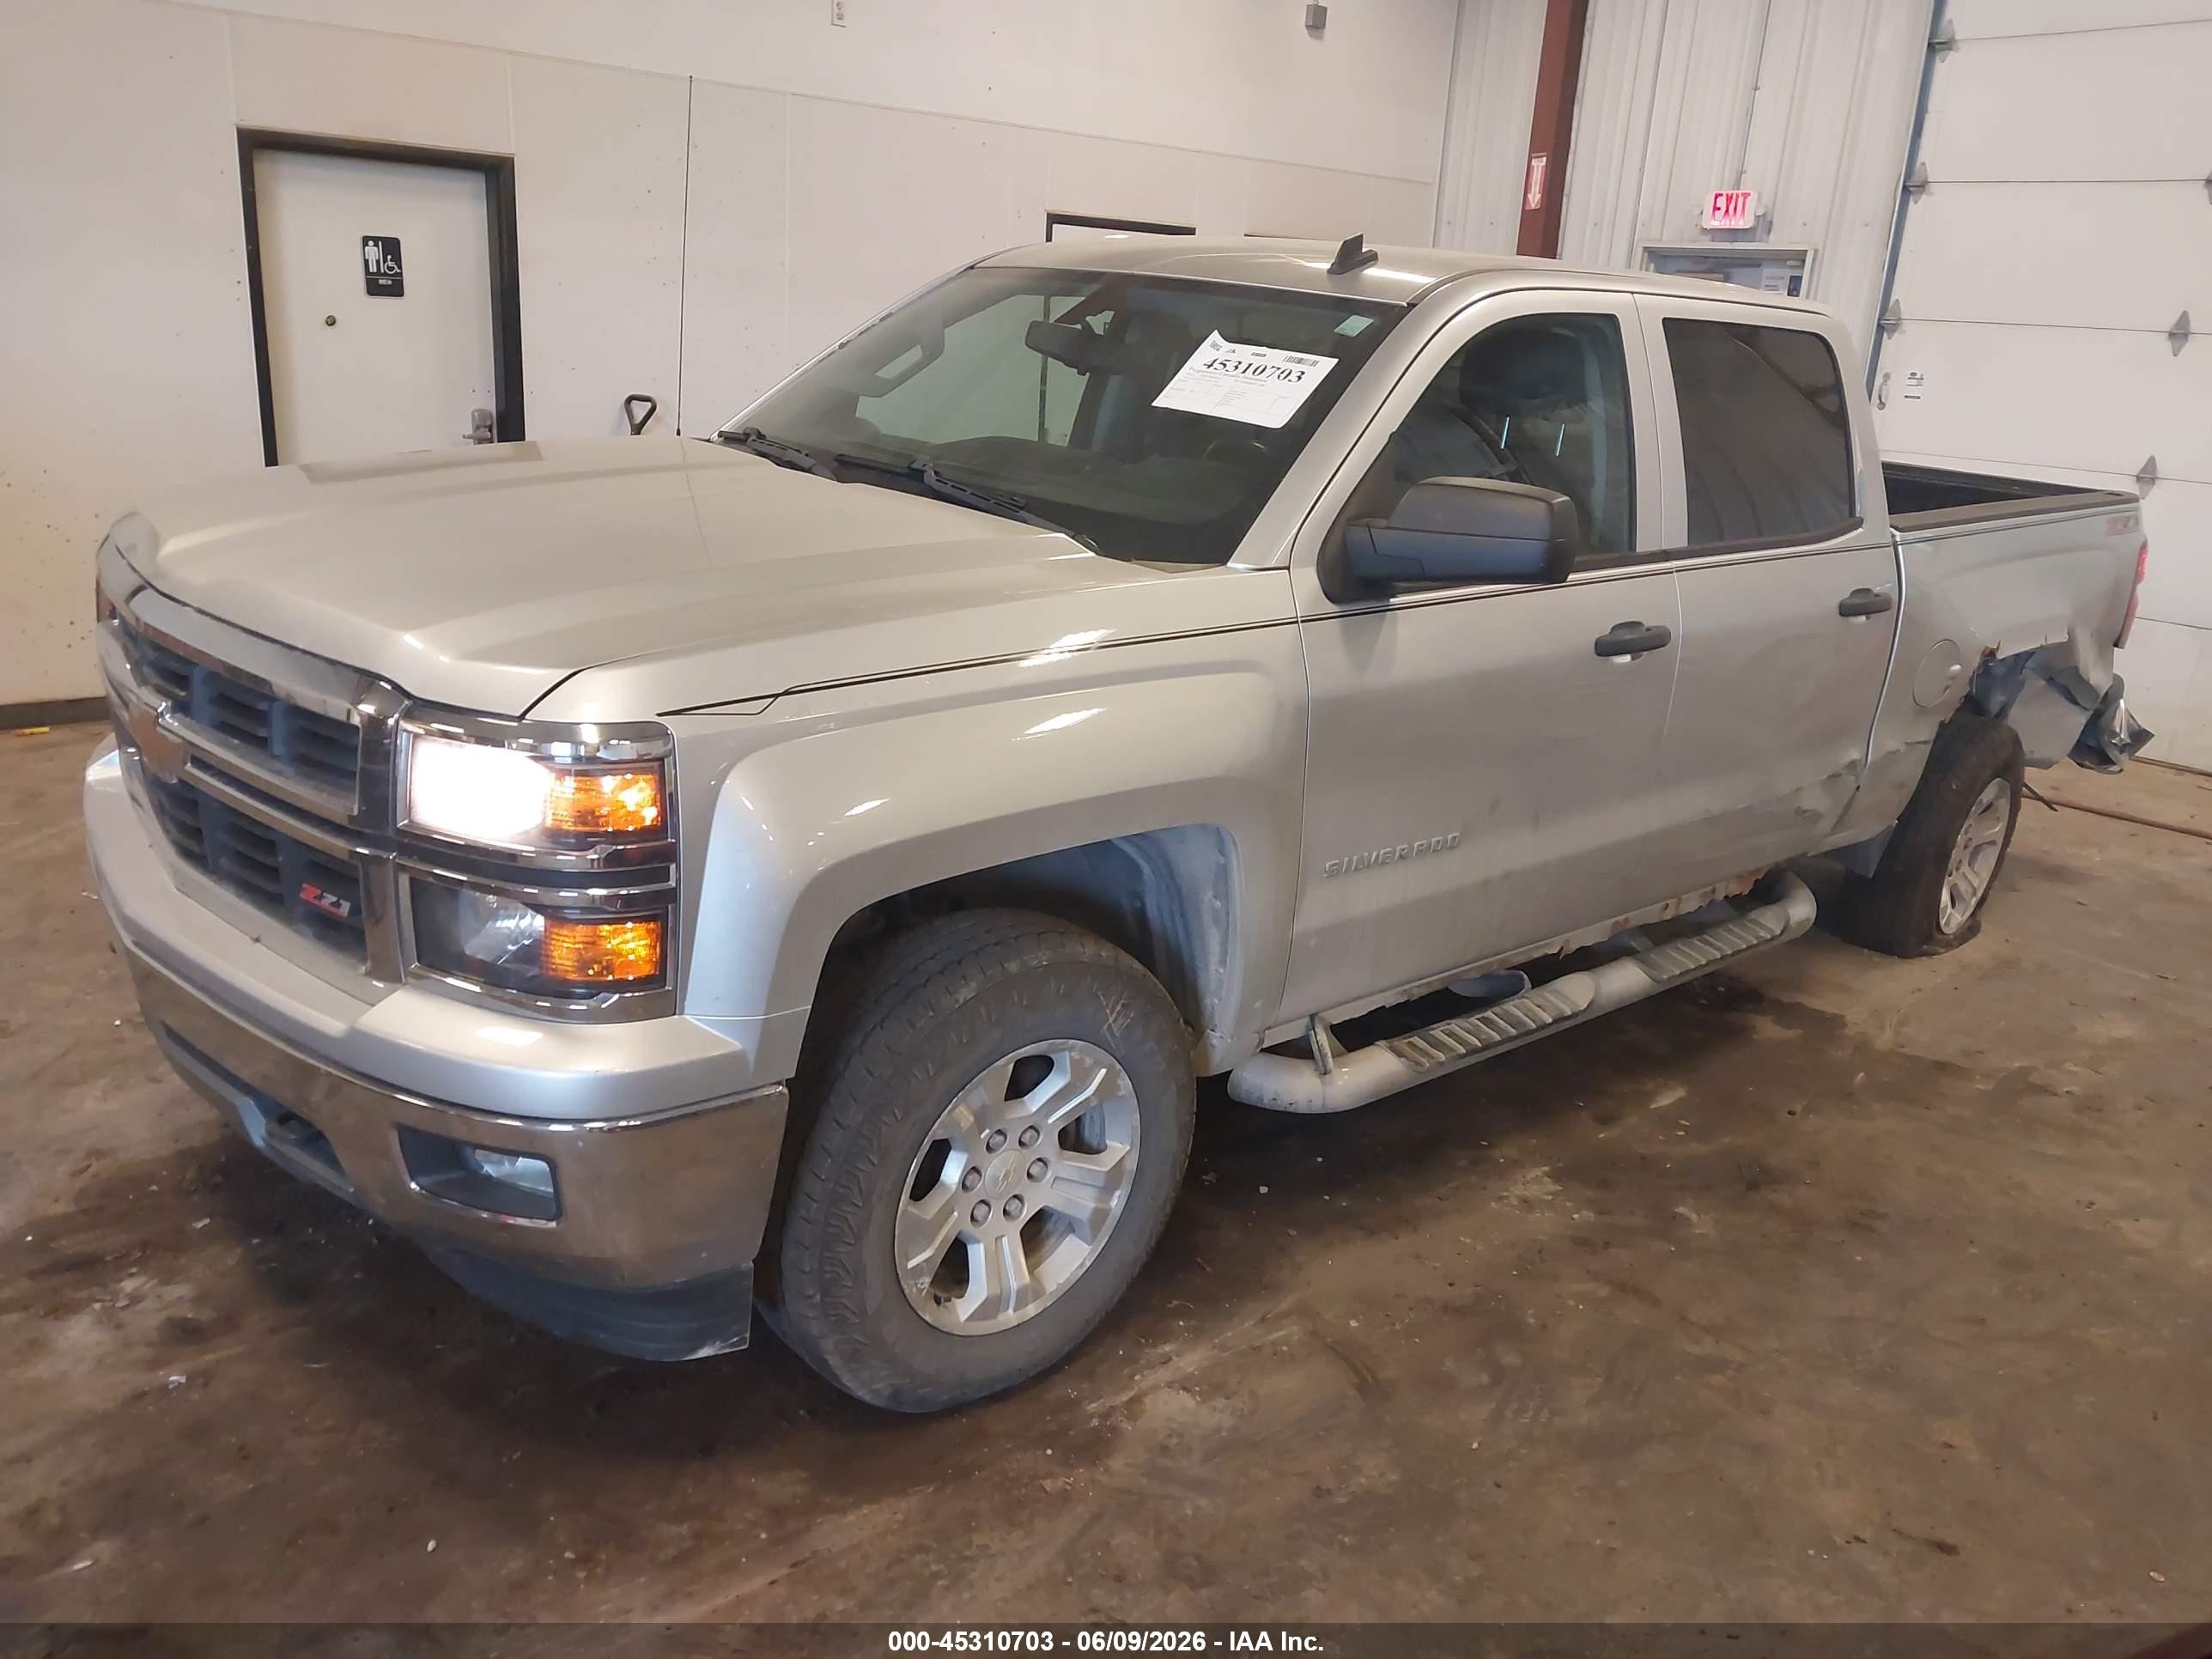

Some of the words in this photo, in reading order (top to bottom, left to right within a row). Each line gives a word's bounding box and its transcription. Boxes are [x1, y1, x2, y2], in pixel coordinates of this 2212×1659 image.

[1710, 191, 1752, 226] EXIT
[1203, 357, 1306, 383] 45310703
[299, 882, 351, 918] Z71
